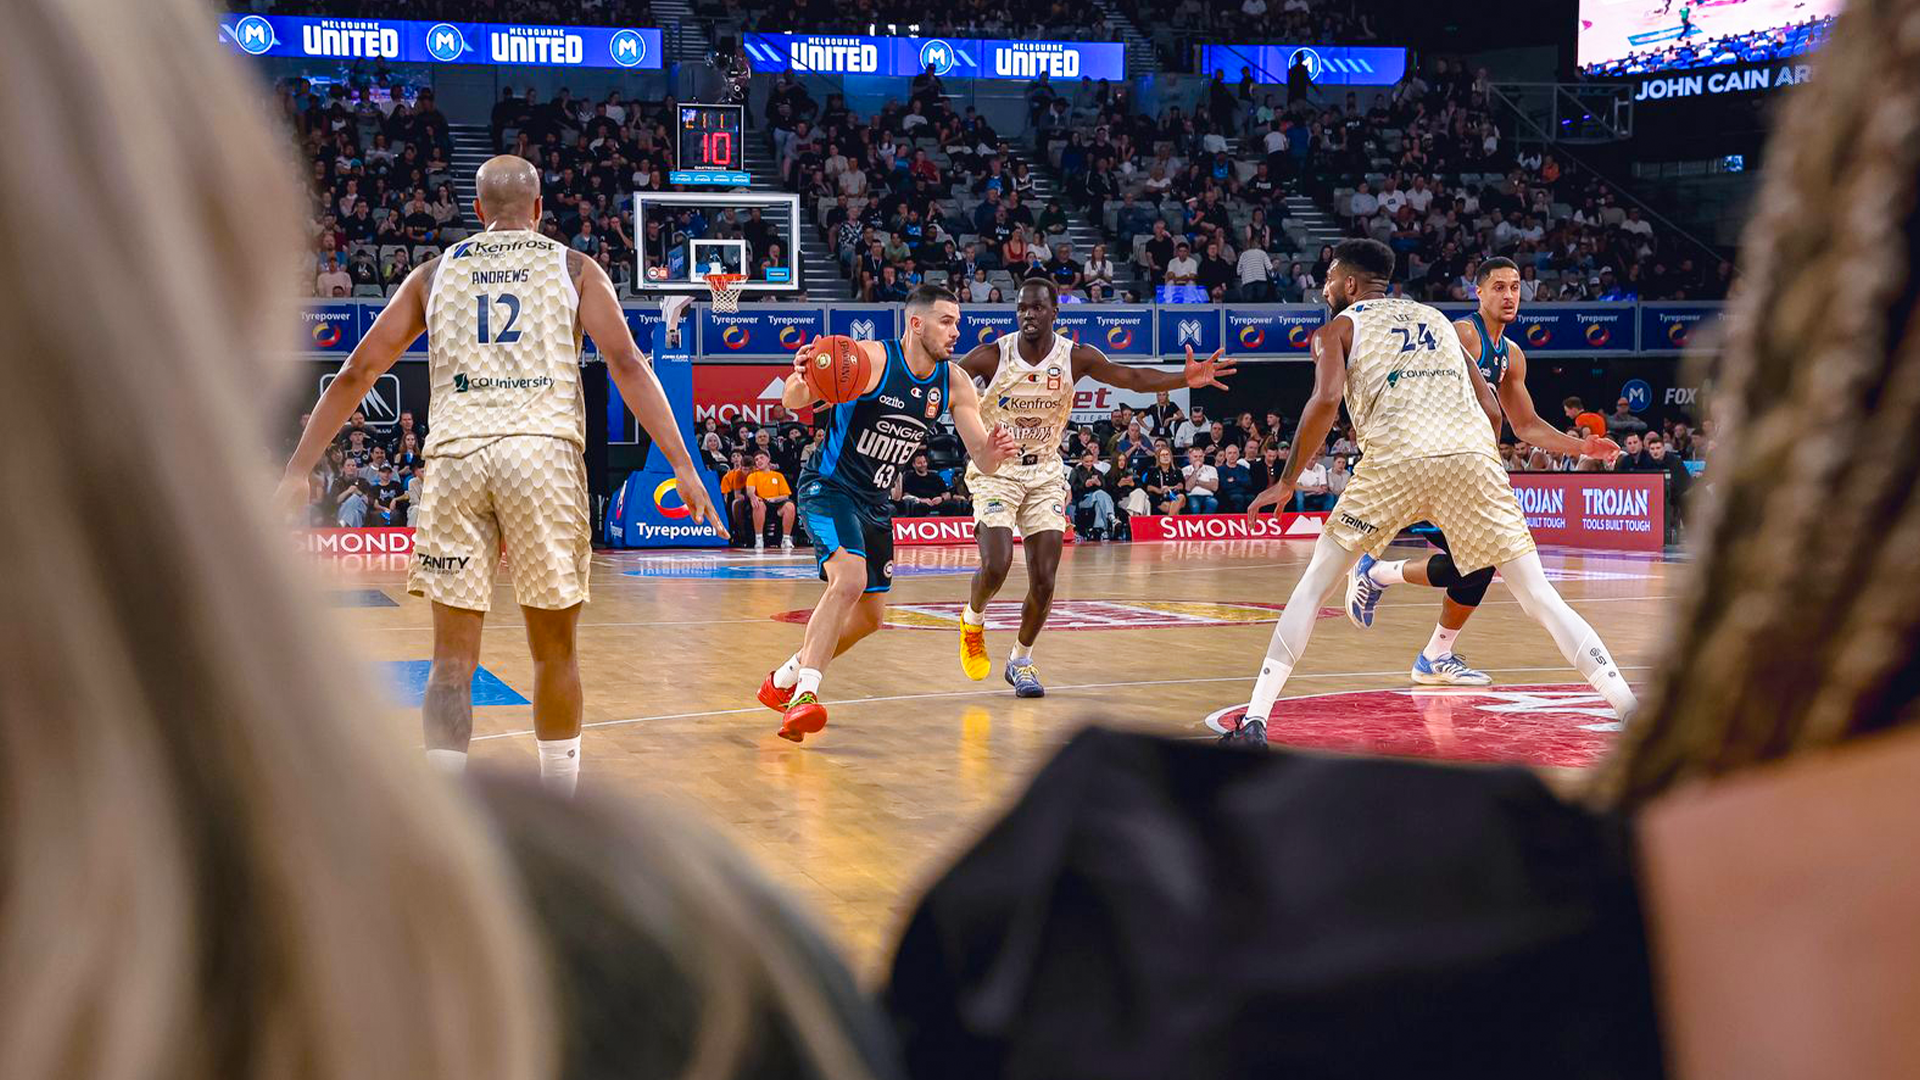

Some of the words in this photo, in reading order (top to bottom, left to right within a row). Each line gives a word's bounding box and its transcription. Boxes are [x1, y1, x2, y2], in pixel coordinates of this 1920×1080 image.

[321, 20, 379, 30] MELBOURNE
[509, 27, 565, 37] MELBOURNE
[303, 25, 399, 58] UNITED
[491, 32, 583, 64] UNITED
[808, 37, 861, 46] MELBOURNE
[1012, 43, 1063, 52] MELBOURNE
[791, 42, 878, 73] UNITED
[996, 48, 1080, 77] UNITED
[1635, 75, 1703, 101] JOHN
[1707, 68, 1770, 93] CAIN
[703, 131, 731, 165] 10
[475, 240, 555, 253] Kenfrost
[472, 268, 530, 285] ANDREWS
[301, 311, 351, 321] Tyrepower
[475, 293, 523, 344] 12
[639, 314, 688, 325] Tyreer
[711, 315, 759, 325] Tyrepower
[768, 315, 815, 326] Tyrepower
[967, 316, 1012, 325] Tyrepower
[1053, 317, 1087, 326] epower
[1096, 316, 1141, 326] Tyrepower
[1229, 315, 1273, 326] Tyrepower
[1278, 315, 1321, 326] Tyrepower
[1517, 314, 1559, 324] Tyrepower
[1576, 314, 1618, 323] Tyrepower
[1659, 313, 1701, 323] Tyrepower
[1391, 323, 1437, 353] 24
[879, 394, 905, 410] ozito
[1664, 387, 1698, 405] FOX
[696, 403, 799, 424] MONDS
[873, 463, 896, 489] 43
[1582, 488, 1648, 516] TROJAN
[1160, 516, 1283, 539] SIMONDS
[1525, 517, 1543, 528] BUILT
[1543, 517, 1566, 529] TOUGH
[1582, 518, 1605, 530] TOOLS
[1605, 519, 1625, 531] BUILT
[1625, 519, 1651, 532] TOUGH
[892, 521, 976, 541] MOND
[293, 530, 420, 554] SIMOND
